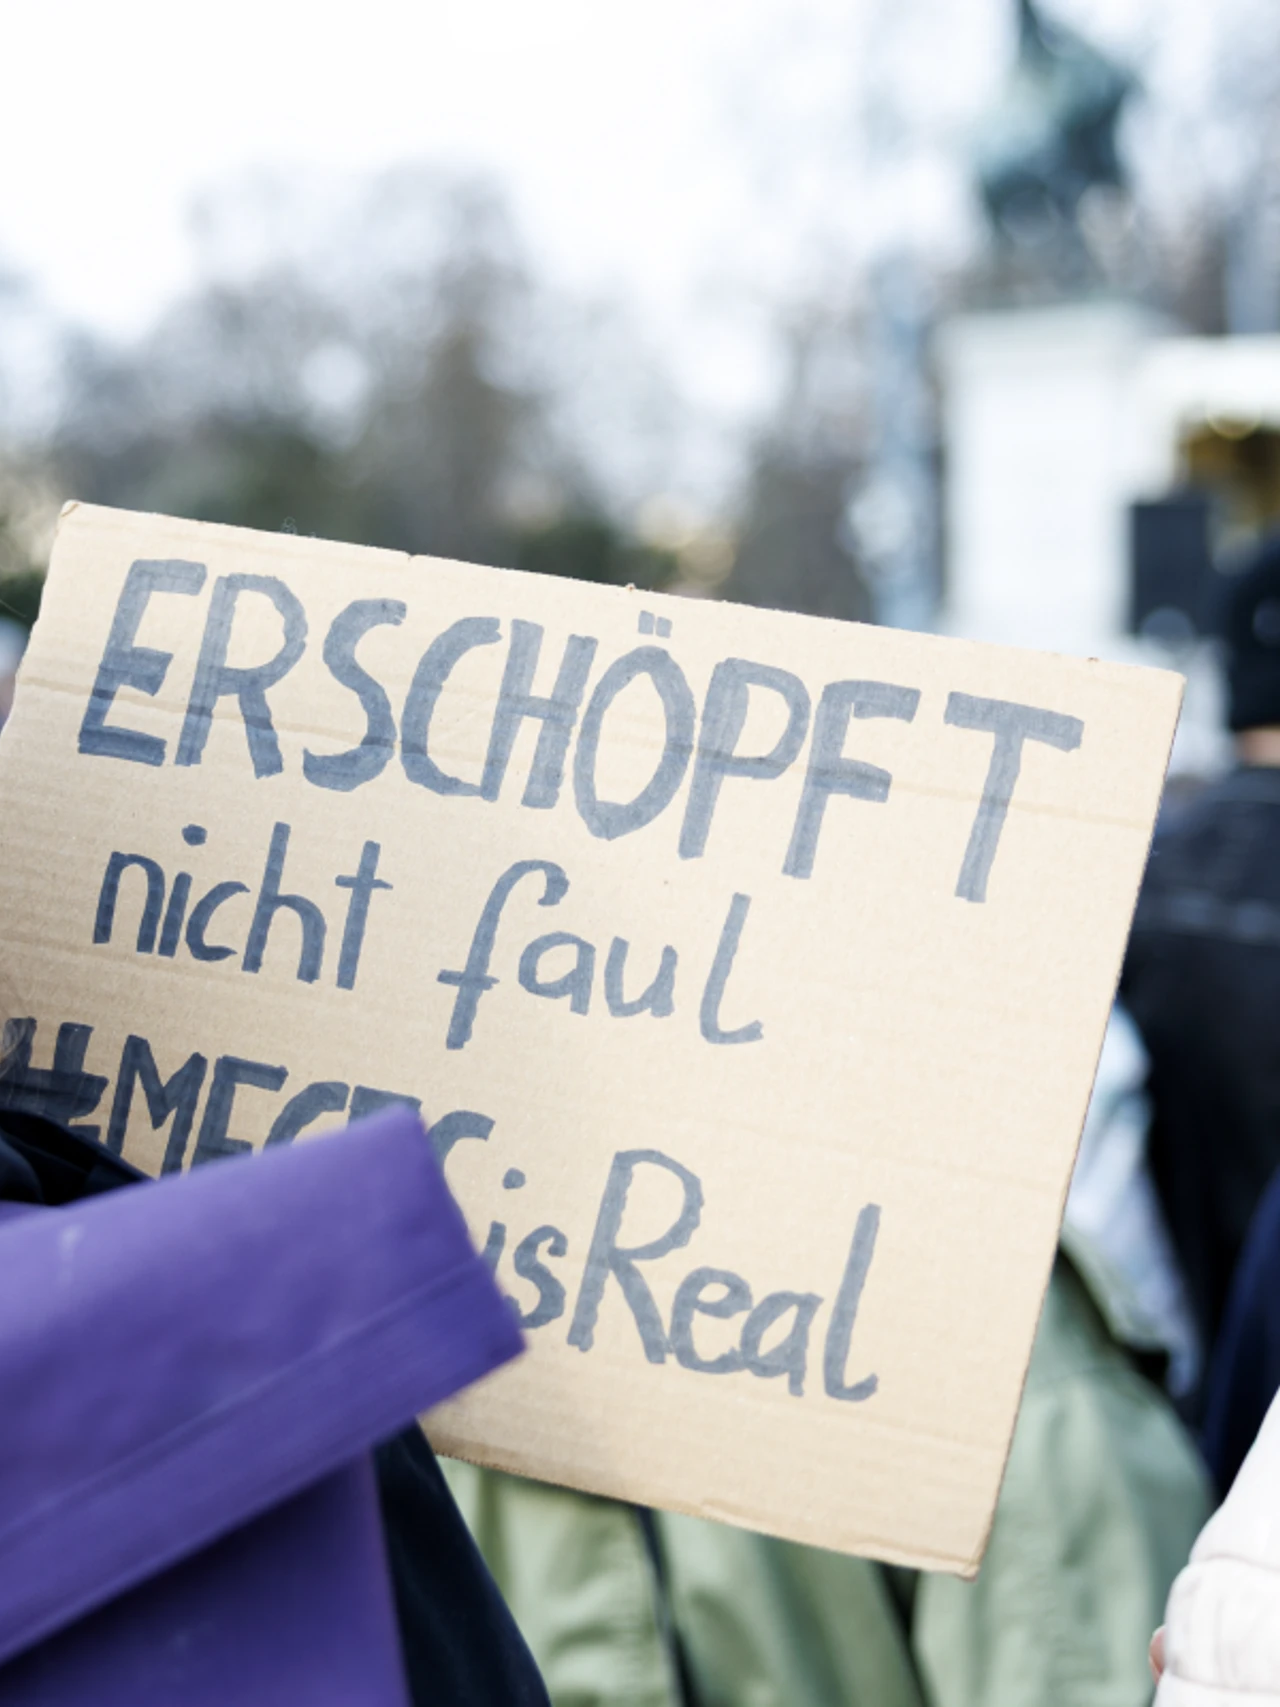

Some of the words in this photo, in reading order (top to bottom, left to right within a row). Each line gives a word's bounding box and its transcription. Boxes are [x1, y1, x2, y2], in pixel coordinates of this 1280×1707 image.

[76, 559, 1084, 902] ERSCHÖPFT
[91, 821, 394, 992] nicht
[435, 859, 764, 1051] faul
